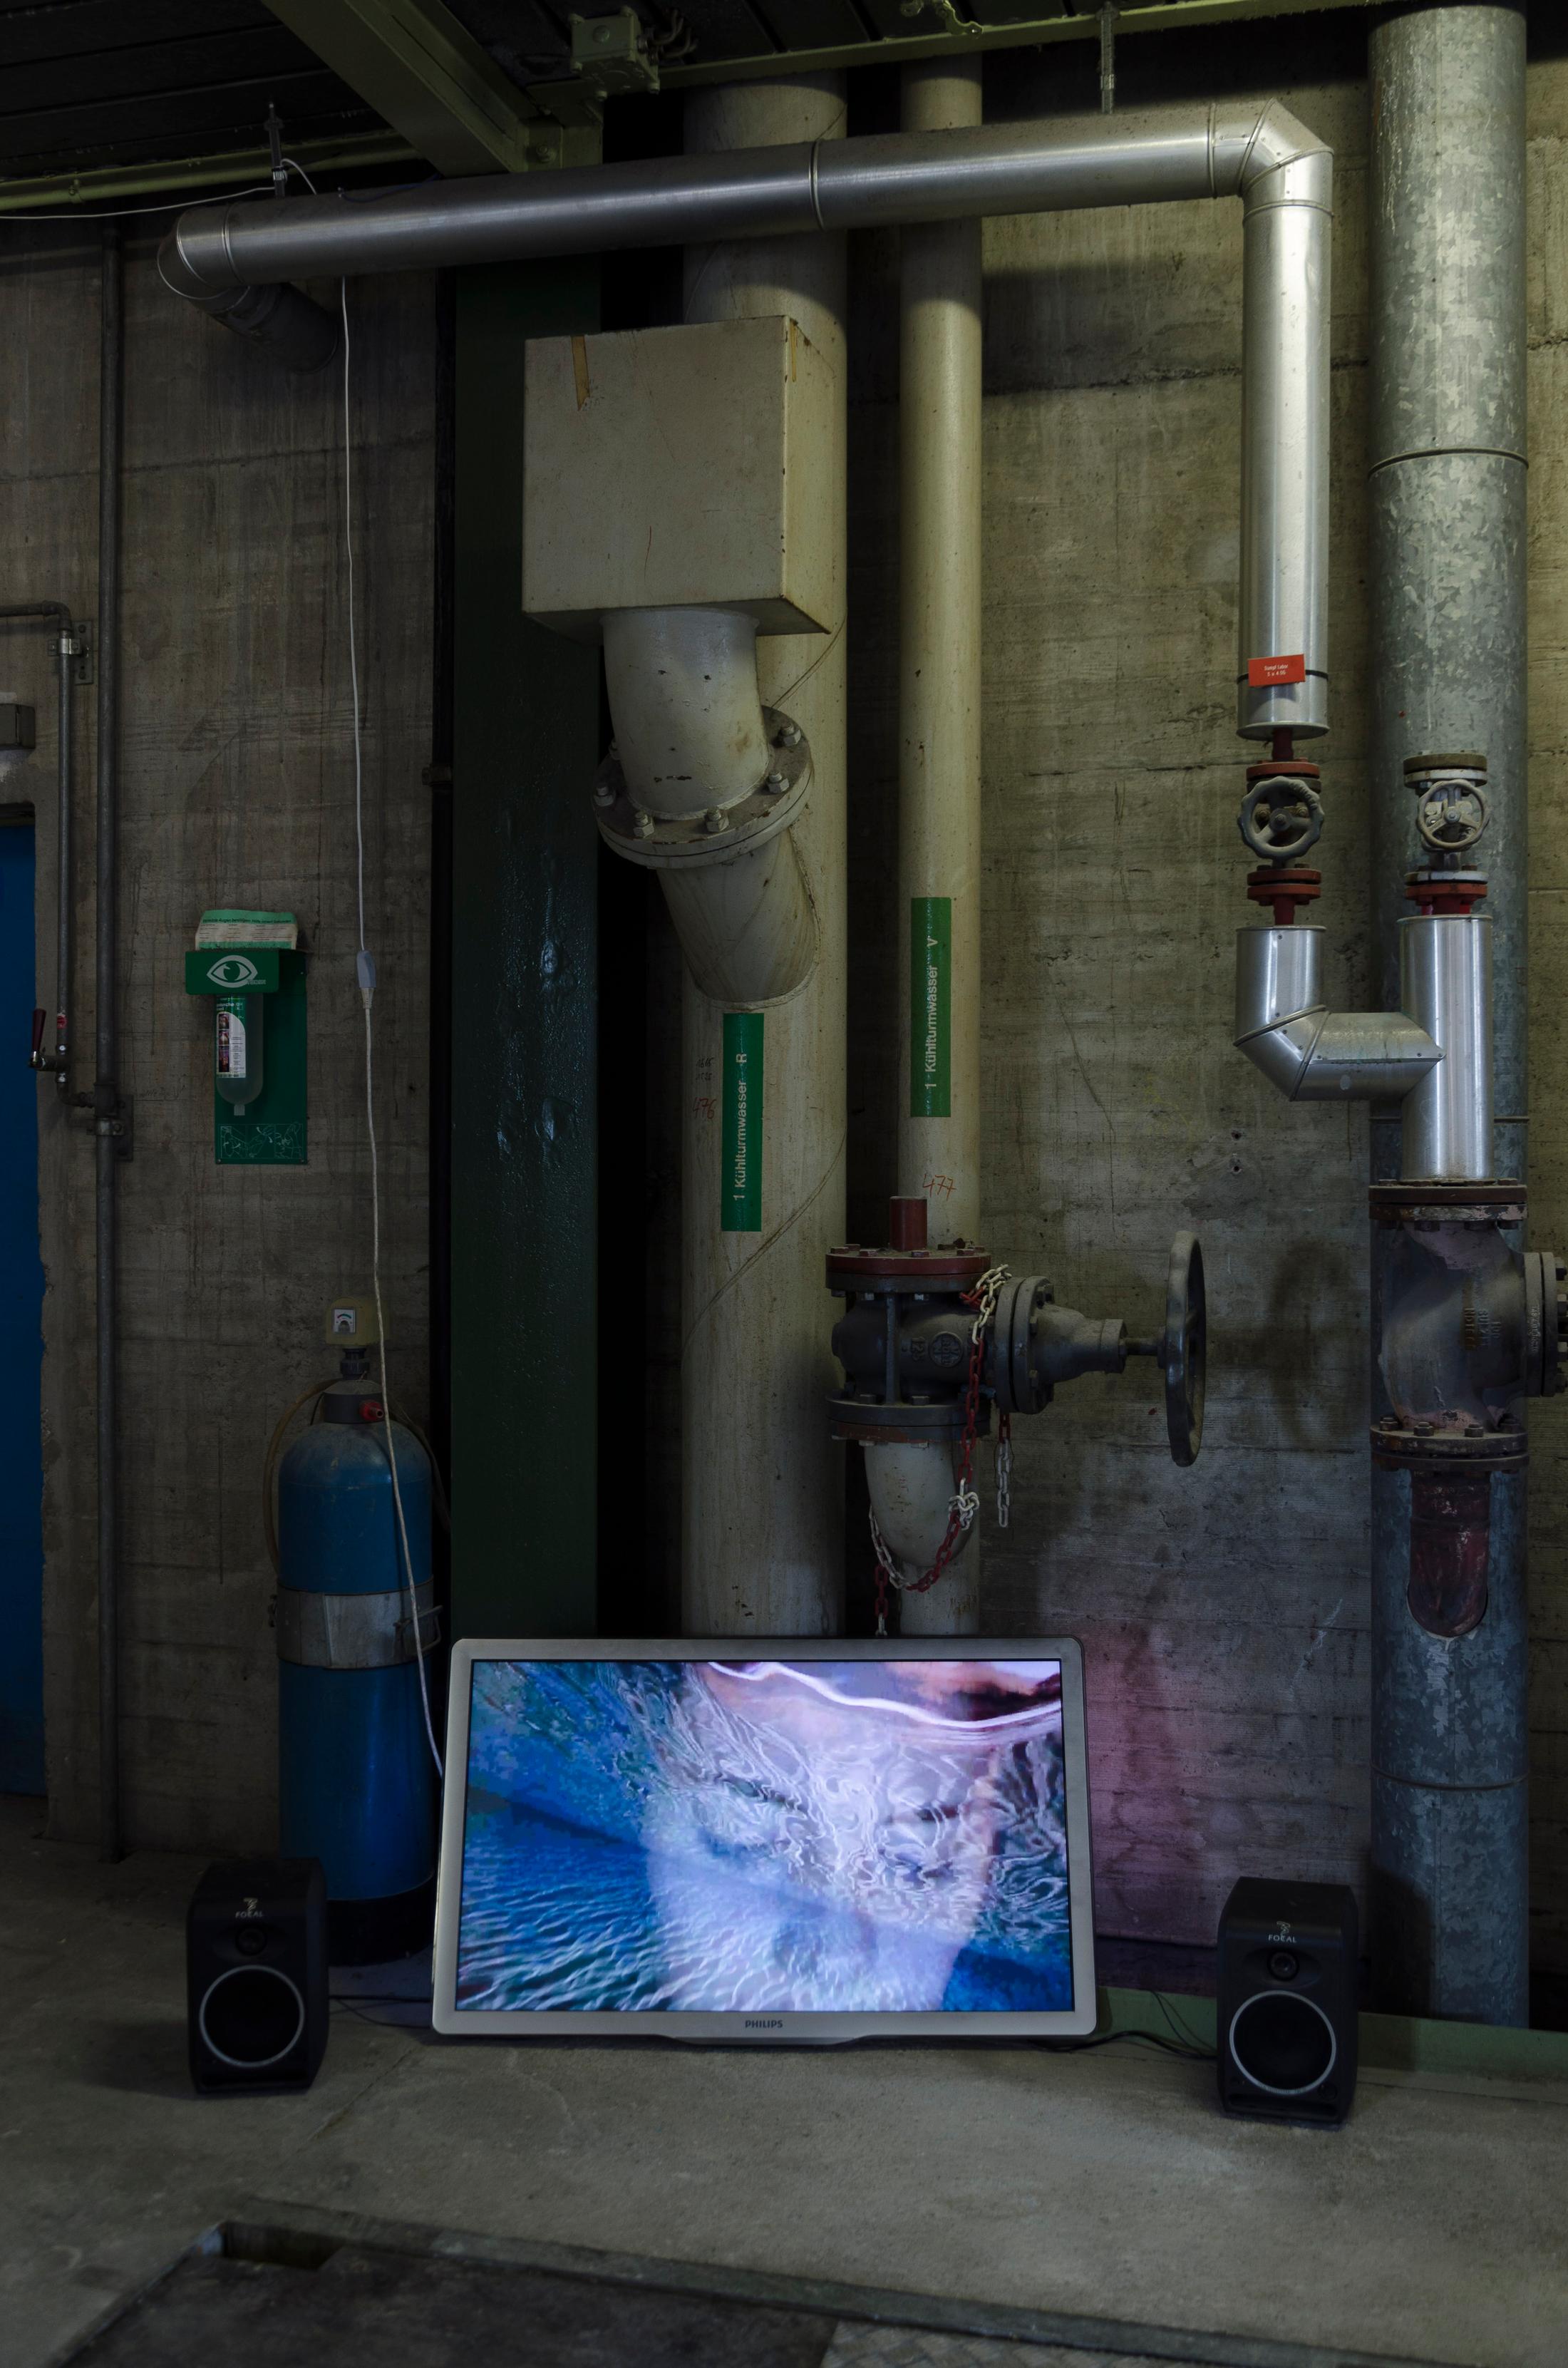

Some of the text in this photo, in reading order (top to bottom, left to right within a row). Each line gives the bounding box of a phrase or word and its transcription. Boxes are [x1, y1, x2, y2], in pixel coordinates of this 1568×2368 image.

[924, 936, 939, 1090] 1 Kühlturmwasser V
[736, 1053, 747, 1064] R
[692, 1096, 716, 1120] 476
[733, 1080, 747, 1188] Kühlturmwasser
[234, 1910, 264, 1919] FOCAL
[1268, 1934, 1297, 1943] FOCAL
[745, 2019, 783, 2029] PHILIPS
